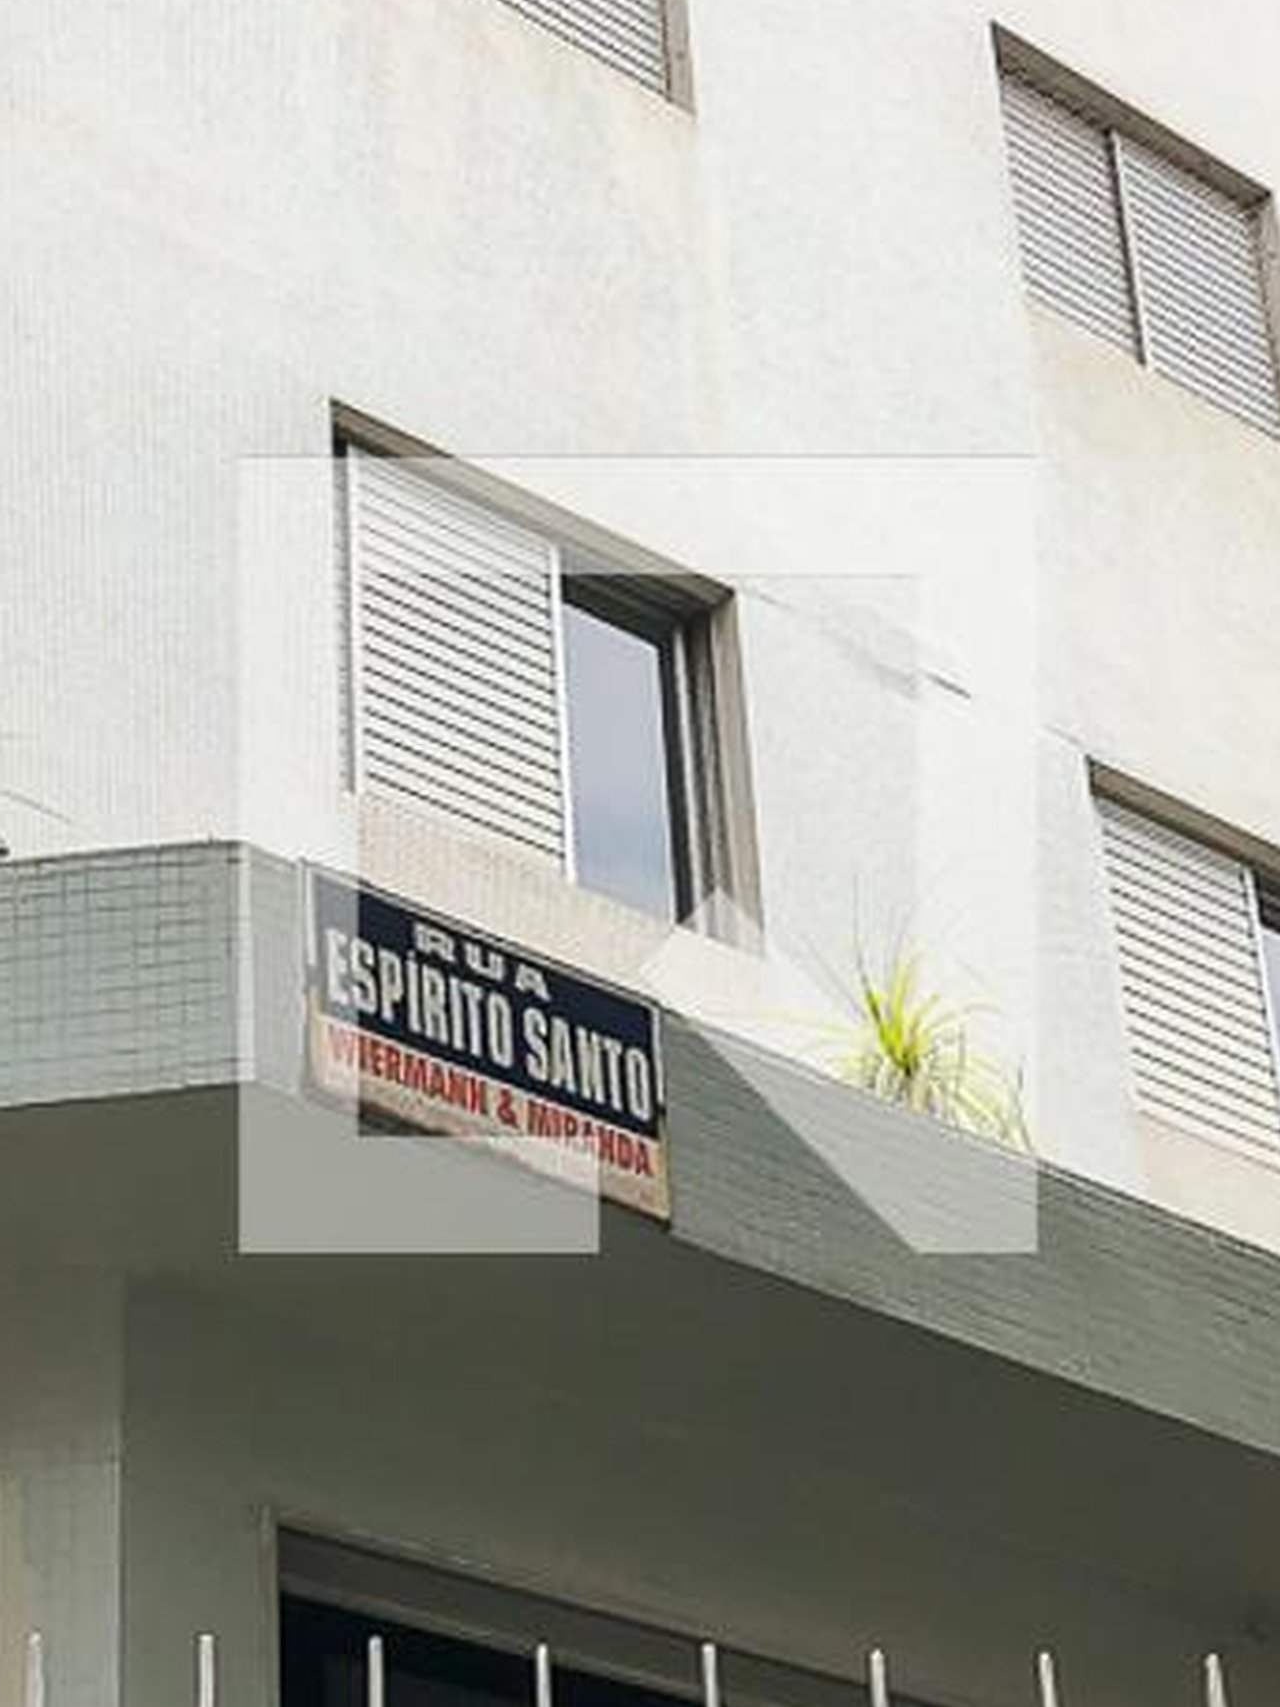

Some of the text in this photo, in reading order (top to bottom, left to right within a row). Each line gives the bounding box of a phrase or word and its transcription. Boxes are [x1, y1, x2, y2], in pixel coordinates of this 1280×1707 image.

[413, 922, 552, 1000] RUA
[325, 927, 651, 1121] ESPÍRITO SANTO
[326, 1023, 488, 1116] WIERMANN
[497, 1088, 519, 1131] &
